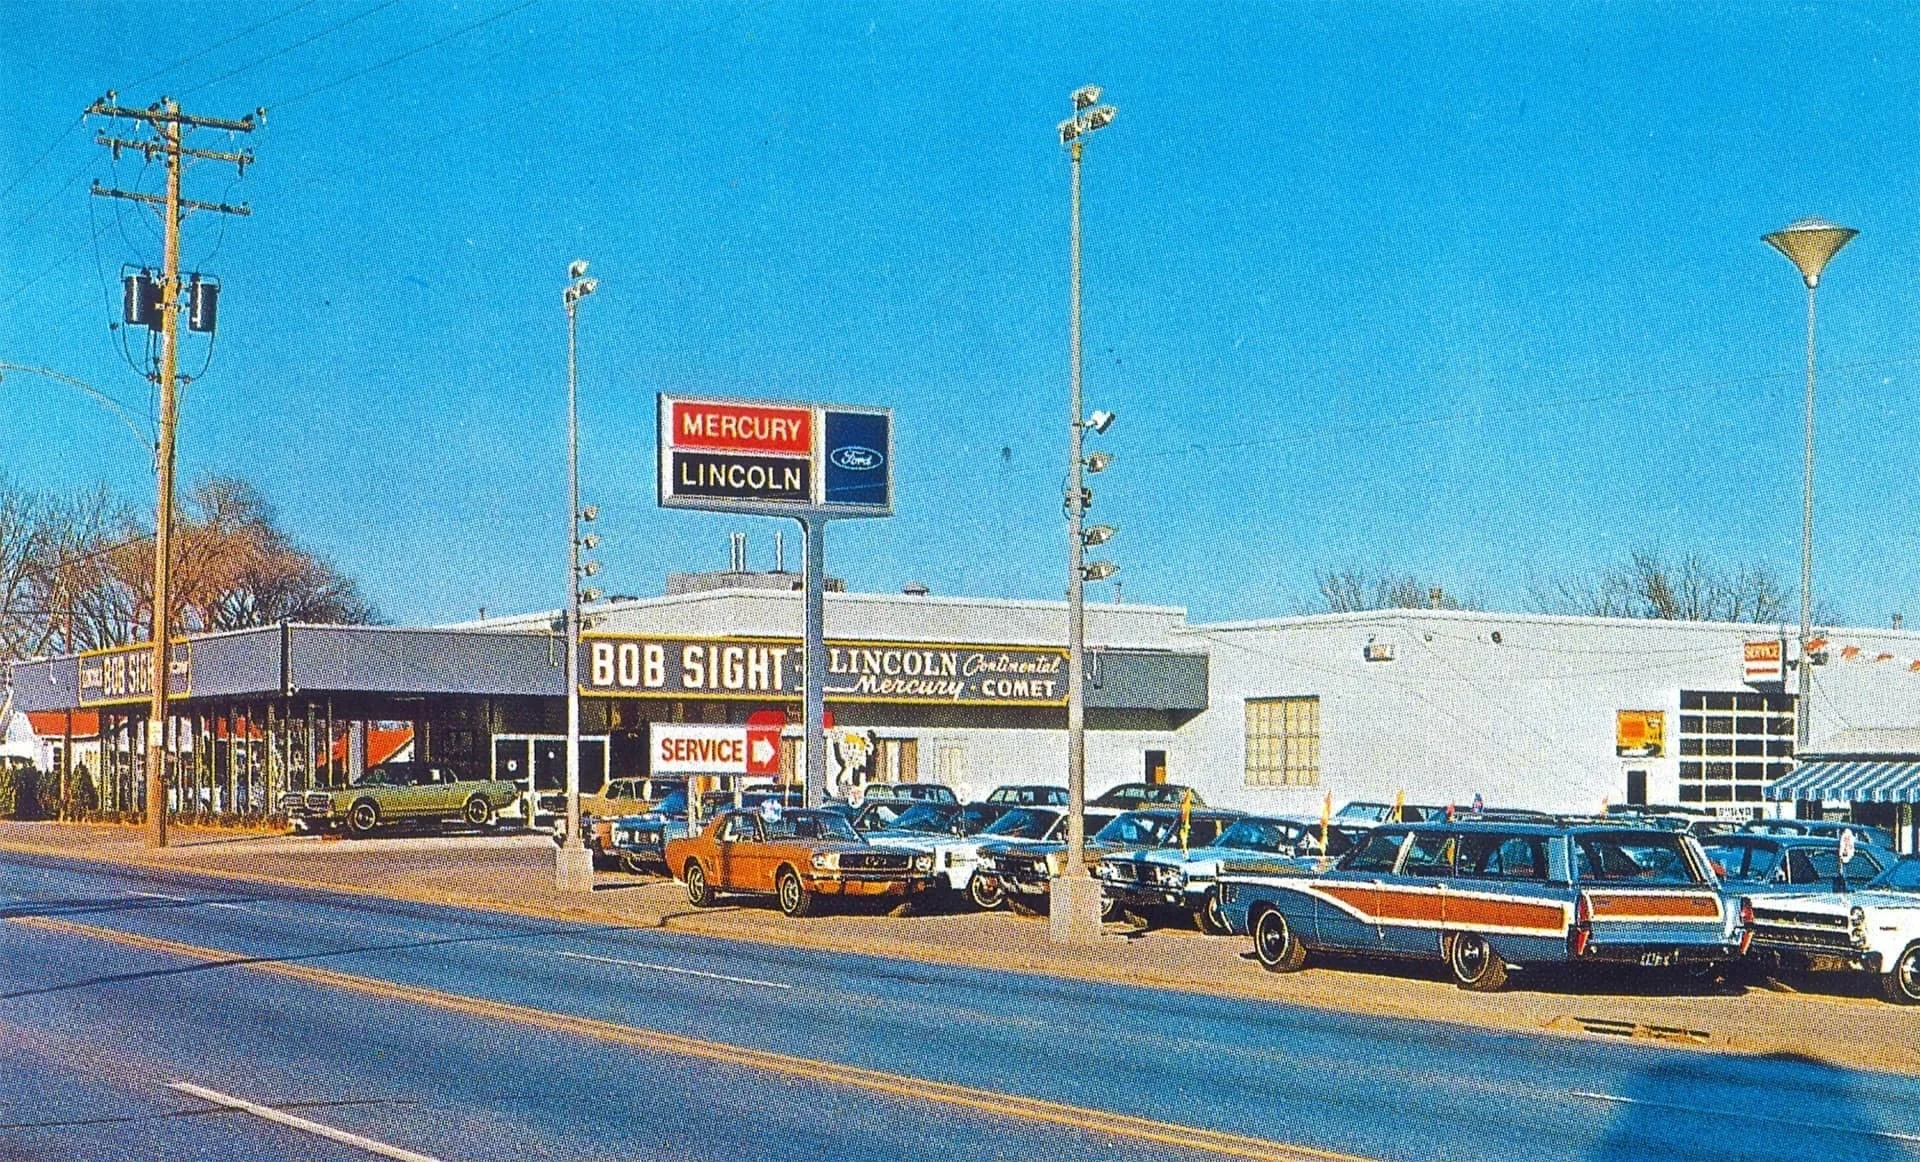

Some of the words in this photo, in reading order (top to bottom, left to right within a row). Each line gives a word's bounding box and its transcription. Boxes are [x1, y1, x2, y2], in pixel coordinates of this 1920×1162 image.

[682, 411, 801, 441] MERCURY
[840, 450, 873, 466] Ford
[682, 461, 801, 491] LINCOLN
[104, 655, 125, 696] BOB
[128, 651, 156, 693] SIGH
[591, 642, 665, 688] BOB
[682, 645, 787, 691] SIGHT
[829, 647, 957, 676] LINCOLN
[962, 653, 1061, 677] Continental
[849, 674, 965, 703] Mercury
[981, 679, 1056, 697] COMET
[661, 737, 744, 763] SERVICE
